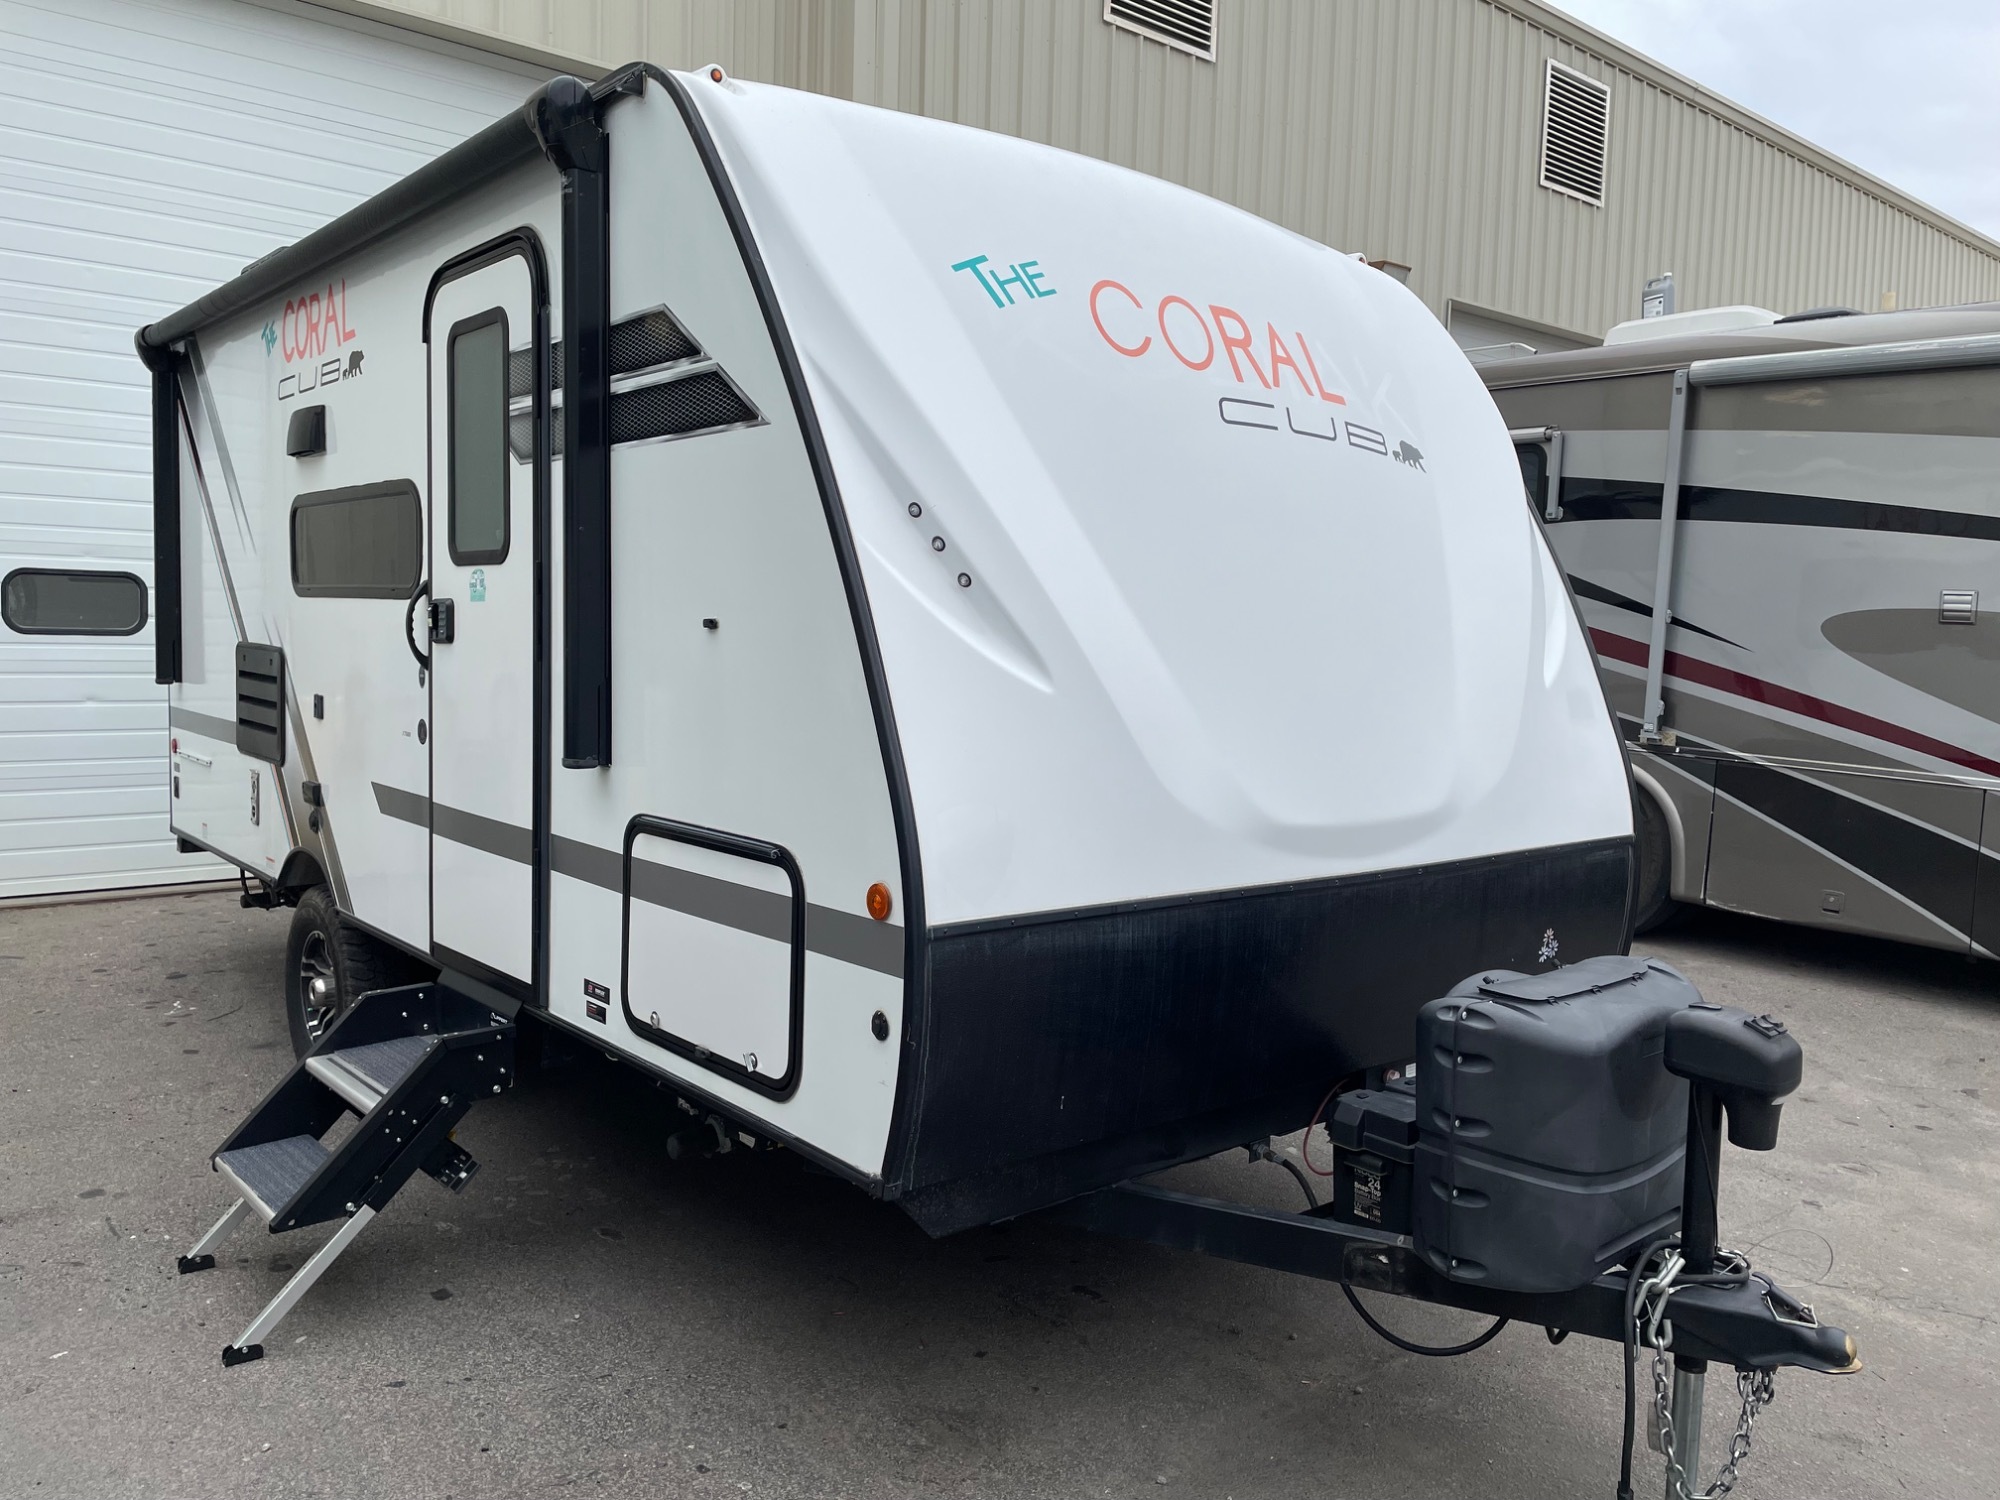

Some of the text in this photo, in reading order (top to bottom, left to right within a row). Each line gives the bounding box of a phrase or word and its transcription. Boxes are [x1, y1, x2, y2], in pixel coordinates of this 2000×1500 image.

[282, 277, 356, 364] CORAL
[951, 254, 1057, 309] THE
[1089, 280, 1347, 406] CORAL
[278, 358, 341, 401] CUB
[1218, 397, 1388, 456] CUB
[1367, 1177, 1381, 1190] 24
